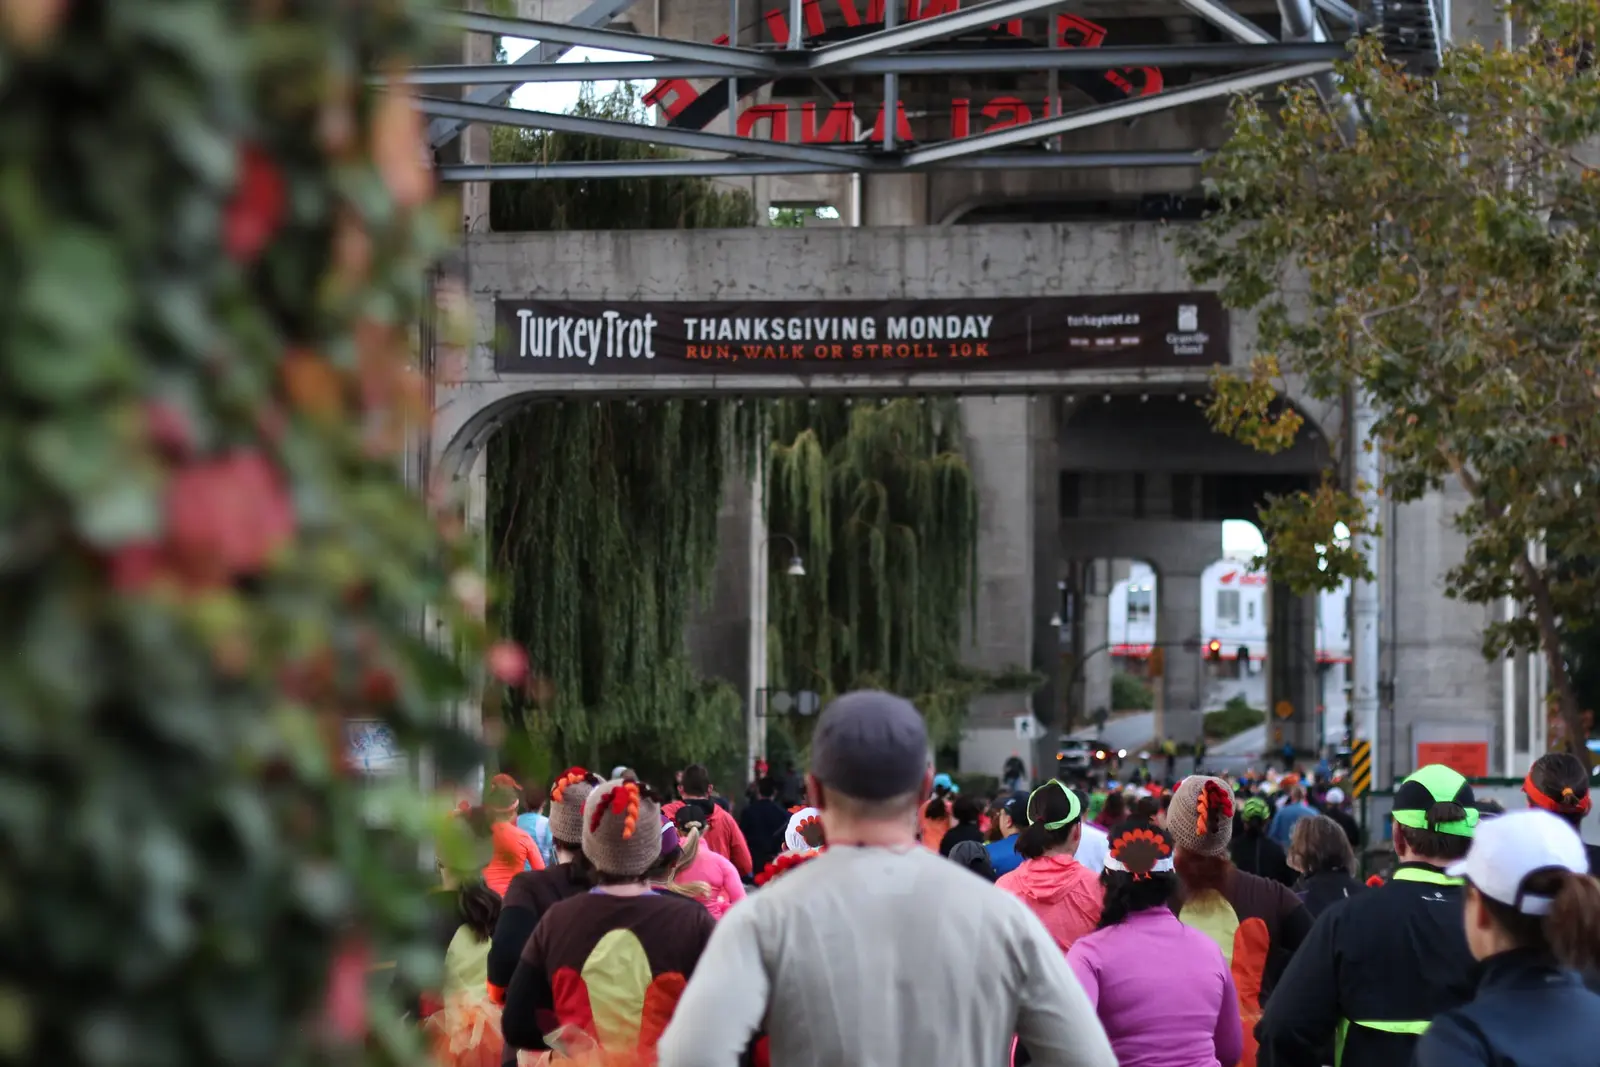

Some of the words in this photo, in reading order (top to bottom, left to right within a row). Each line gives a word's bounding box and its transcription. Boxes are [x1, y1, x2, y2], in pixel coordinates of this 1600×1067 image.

[683, 316, 876, 341] THANKSGIVING
[887, 315, 993, 340] MONDAY
[686, 344, 738, 361] RUN,
[741, 344, 805, 359] WALK
[814, 344, 844, 359] OR
[852, 343, 939, 359] STROLL
[950, 342, 989, 358] 10K
